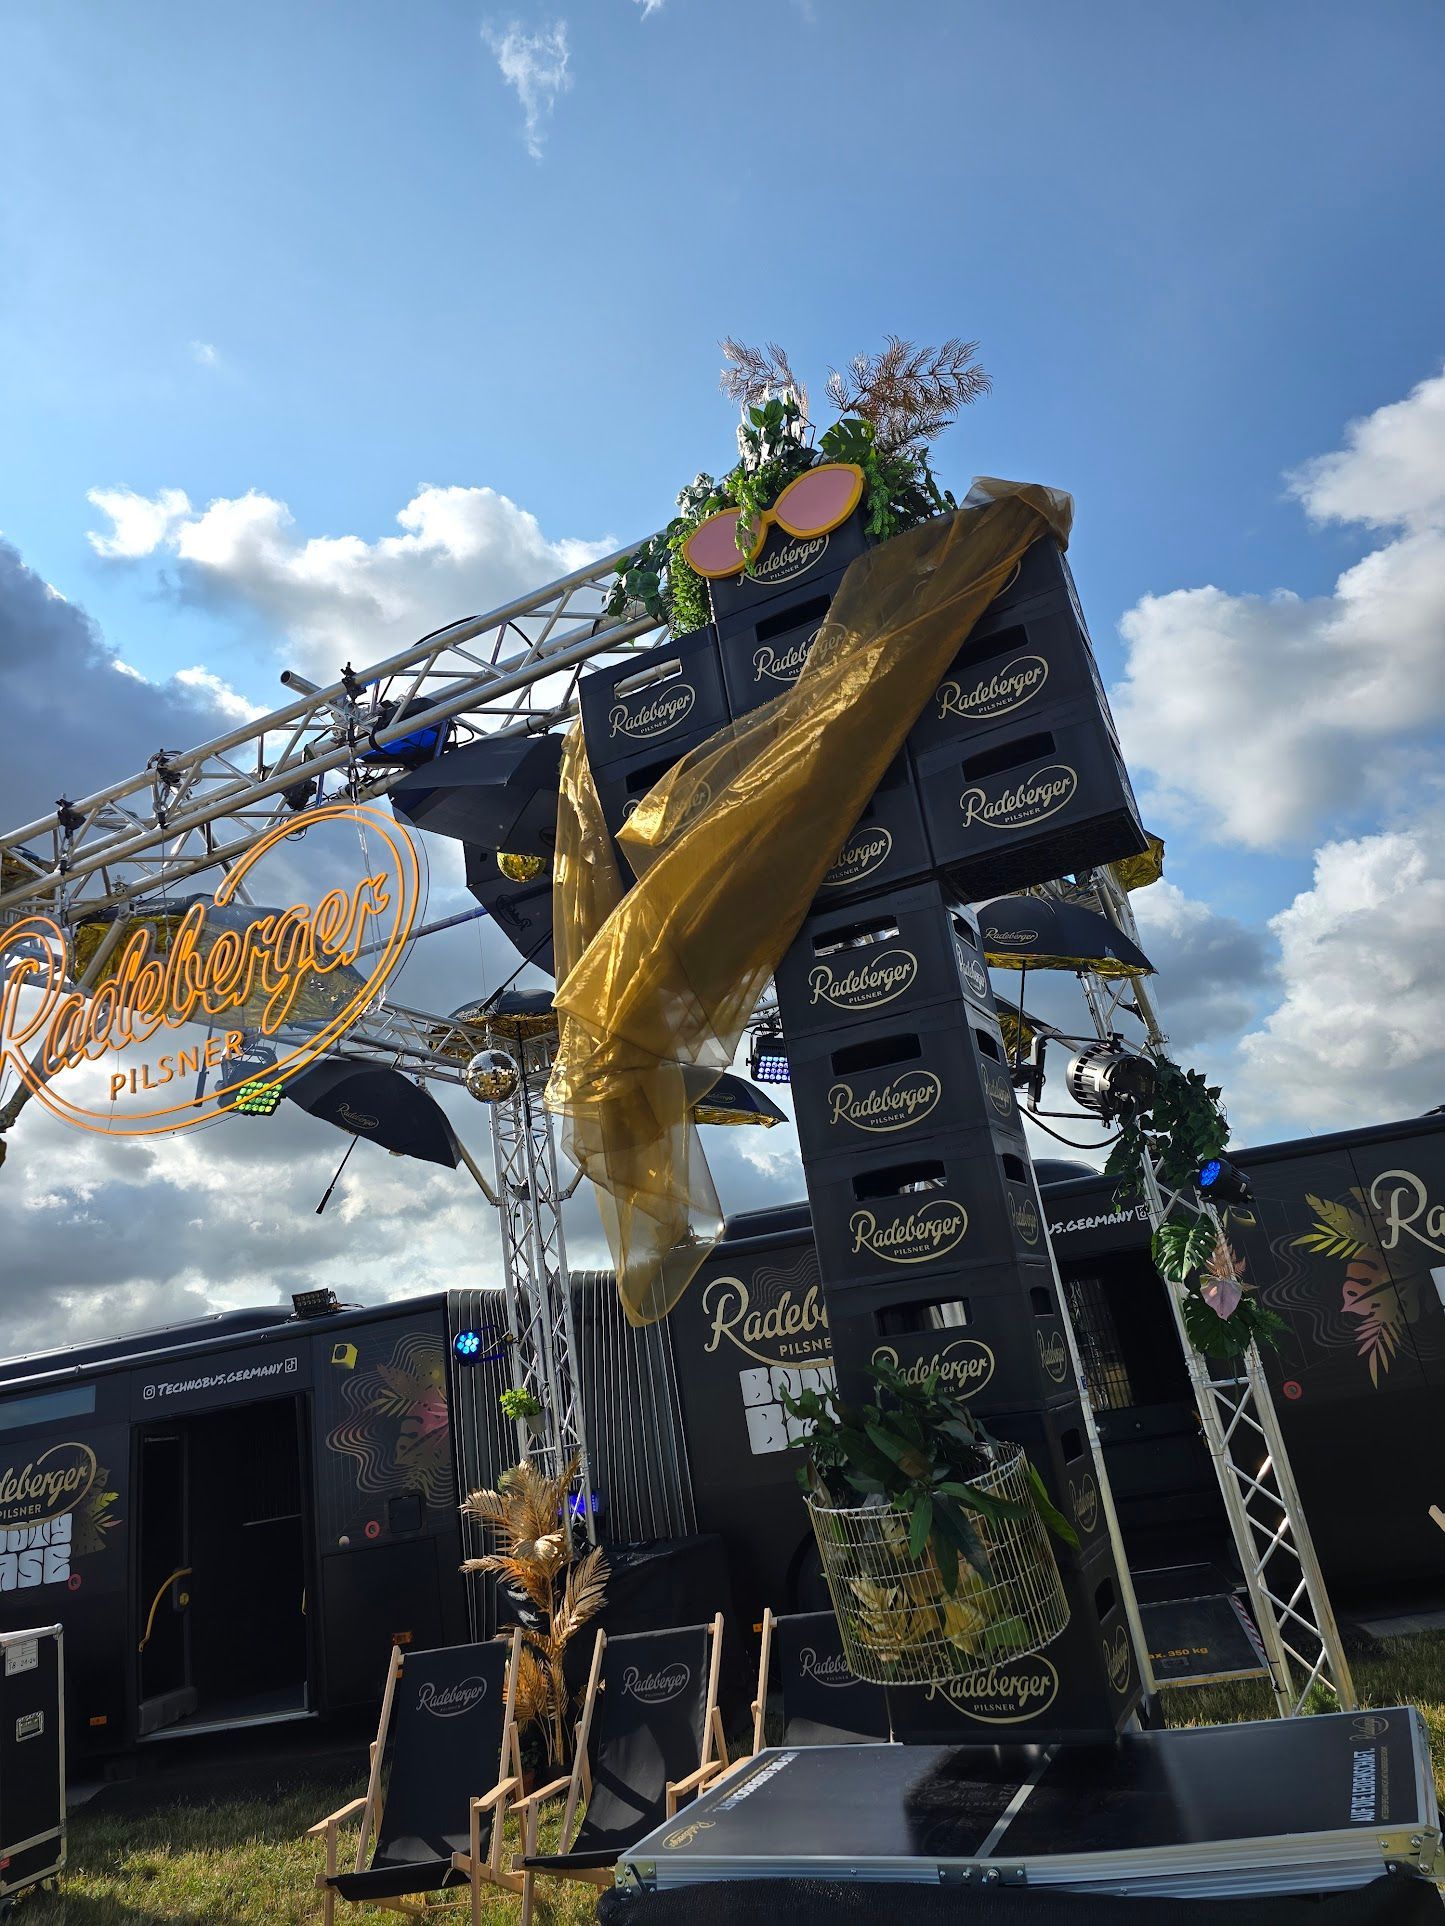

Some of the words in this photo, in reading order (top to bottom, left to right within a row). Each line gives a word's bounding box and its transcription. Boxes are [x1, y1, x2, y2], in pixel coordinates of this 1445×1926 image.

[770, 564, 800, 580] PILSNER
[936, 667, 1042, 719] Radeberger
[978, 697, 1013, 713] PILSNER
[609, 694, 691, 739] Radeberger
[640, 719, 668, 734] PILSNER
[960, 776, 1072, 827] Radeberger
[1004, 807, 1041, 823] PILSNER
[808, 962, 911, 1005] Radeberger
[848, 990, 883, 1004] PILSNER
[110, 1029, 245, 1101] PILSNER
[828, 1083, 936, 1125] Radeberger
[870, 1112, 906, 1126] PILSNER
[849, 1210, 961, 1255] Radeberger
[893, 1243, 931, 1257] PILSNER
[779, 1337, 832, 1357] PILSNE
[157, 1362, 284, 1397] TECHNOBUS.GERMANY
[799, 1647, 849, 1677] Radebe
[1167, 1649, 1190, 1657] 350
[620, 1666, 686, 1695] Radeberger
[415, 1682, 483, 1711] Radeberger
[973, 1703, 1016, 1711] PILSNER
[1351, 1795, 1376, 1809] DIE
[1350, 1809, 1376, 1822] AUF
